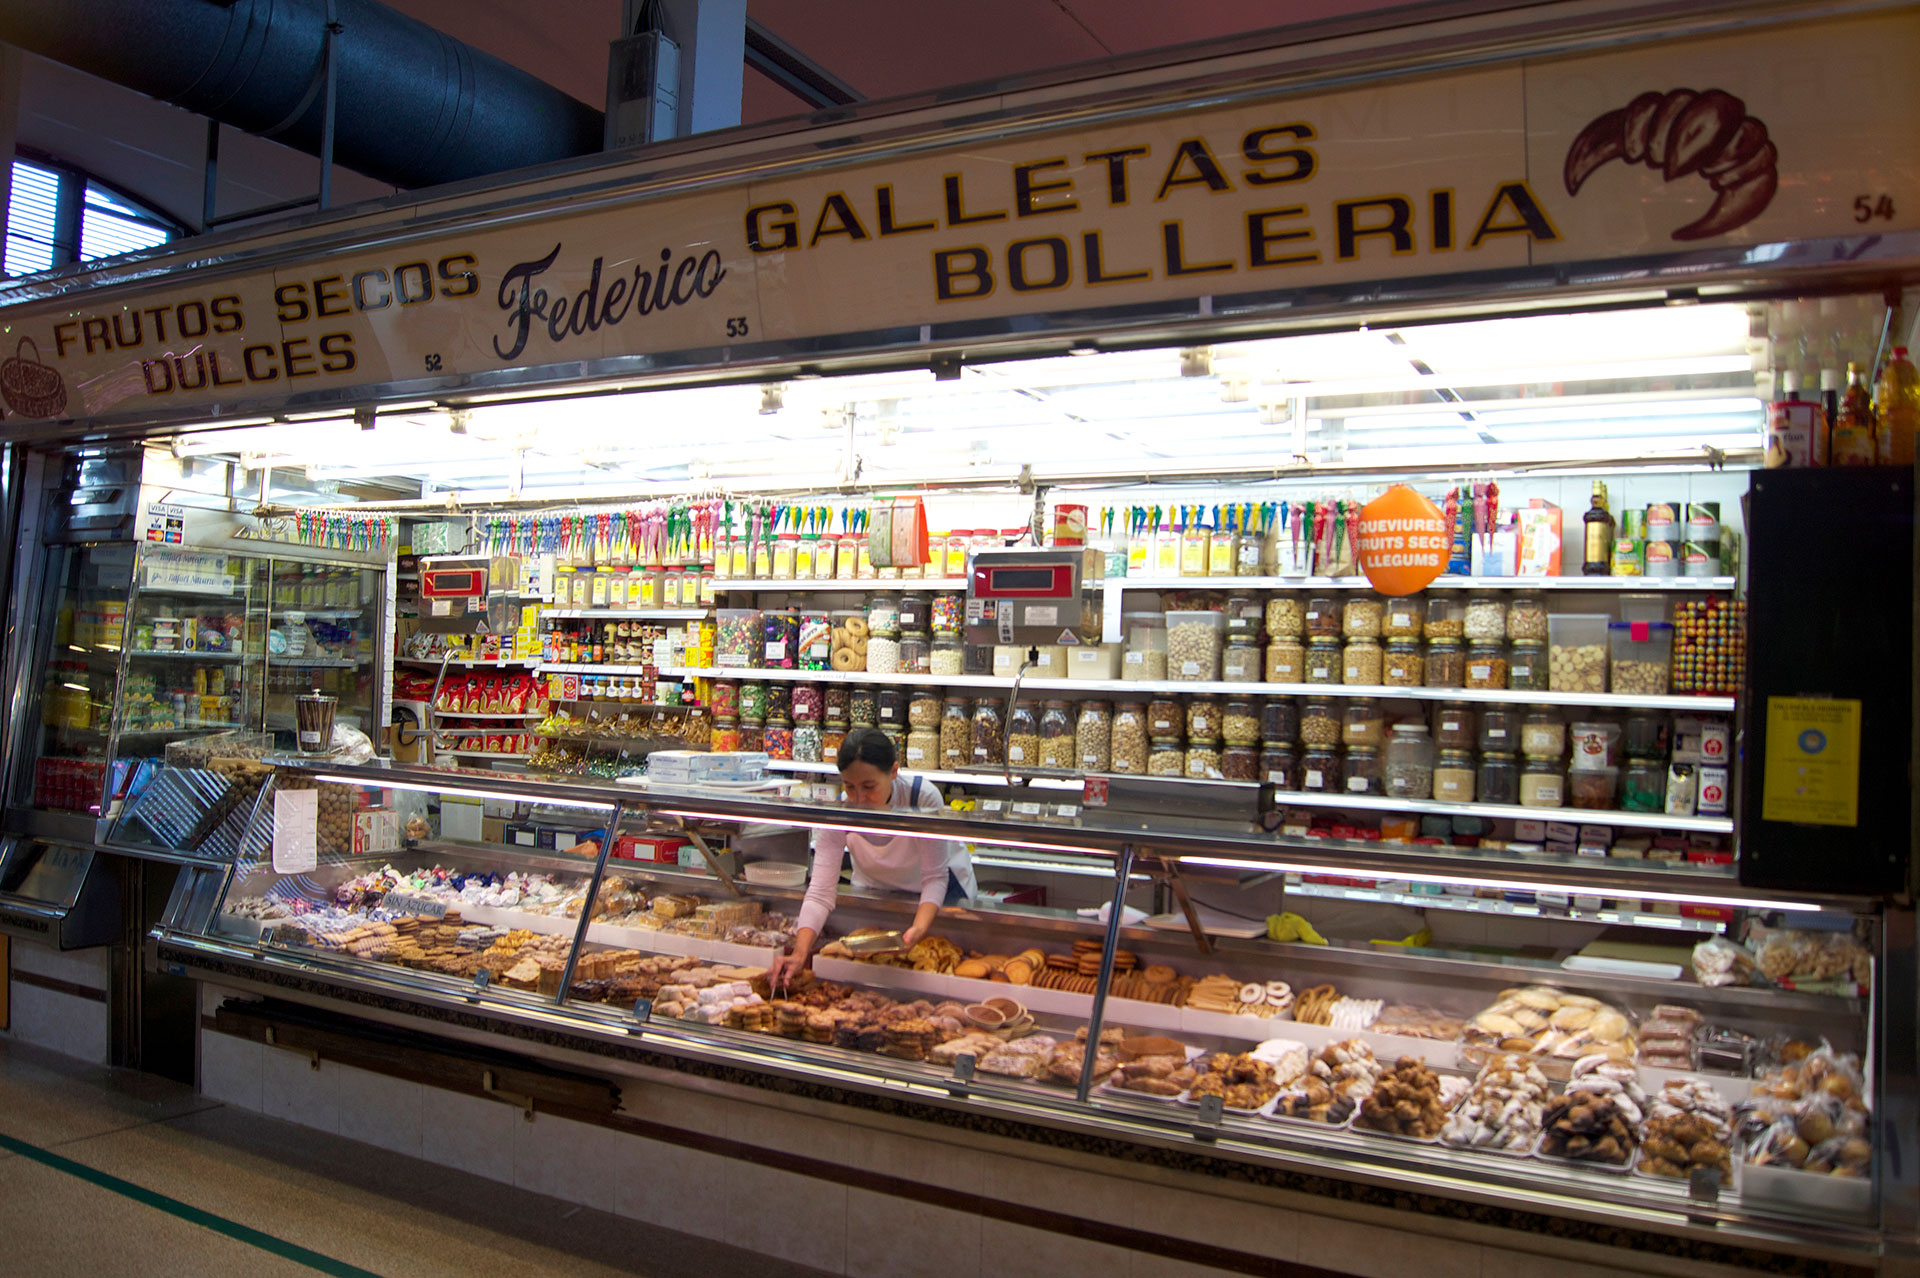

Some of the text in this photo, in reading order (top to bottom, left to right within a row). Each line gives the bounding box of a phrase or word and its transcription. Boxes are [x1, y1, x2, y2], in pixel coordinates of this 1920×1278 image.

[743, 120, 1318, 256] GALLETAS
[1854, 195, 1896, 224] 54
[931, 181, 1564, 304] BOLLERIA
[53, 251, 481, 360] FRUTOS SECOS
[493, 241, 727, 361] Federico
[726, 316, 749, 338] 53
[140, 331, 357, 397] DULCES
[424, 353, 443, 373] 52
[151, 504, 166, 513] VISA
[169, 507, 184, 515] VISA
[1358, 518, 1446, 534] QUEVIURES
[1357, 535, 1449, 551] FRUITS SECS
[1367, 553, 1440, 568] LLEGUMS
[387, 895, 442, 915] SIN AZUCAR
